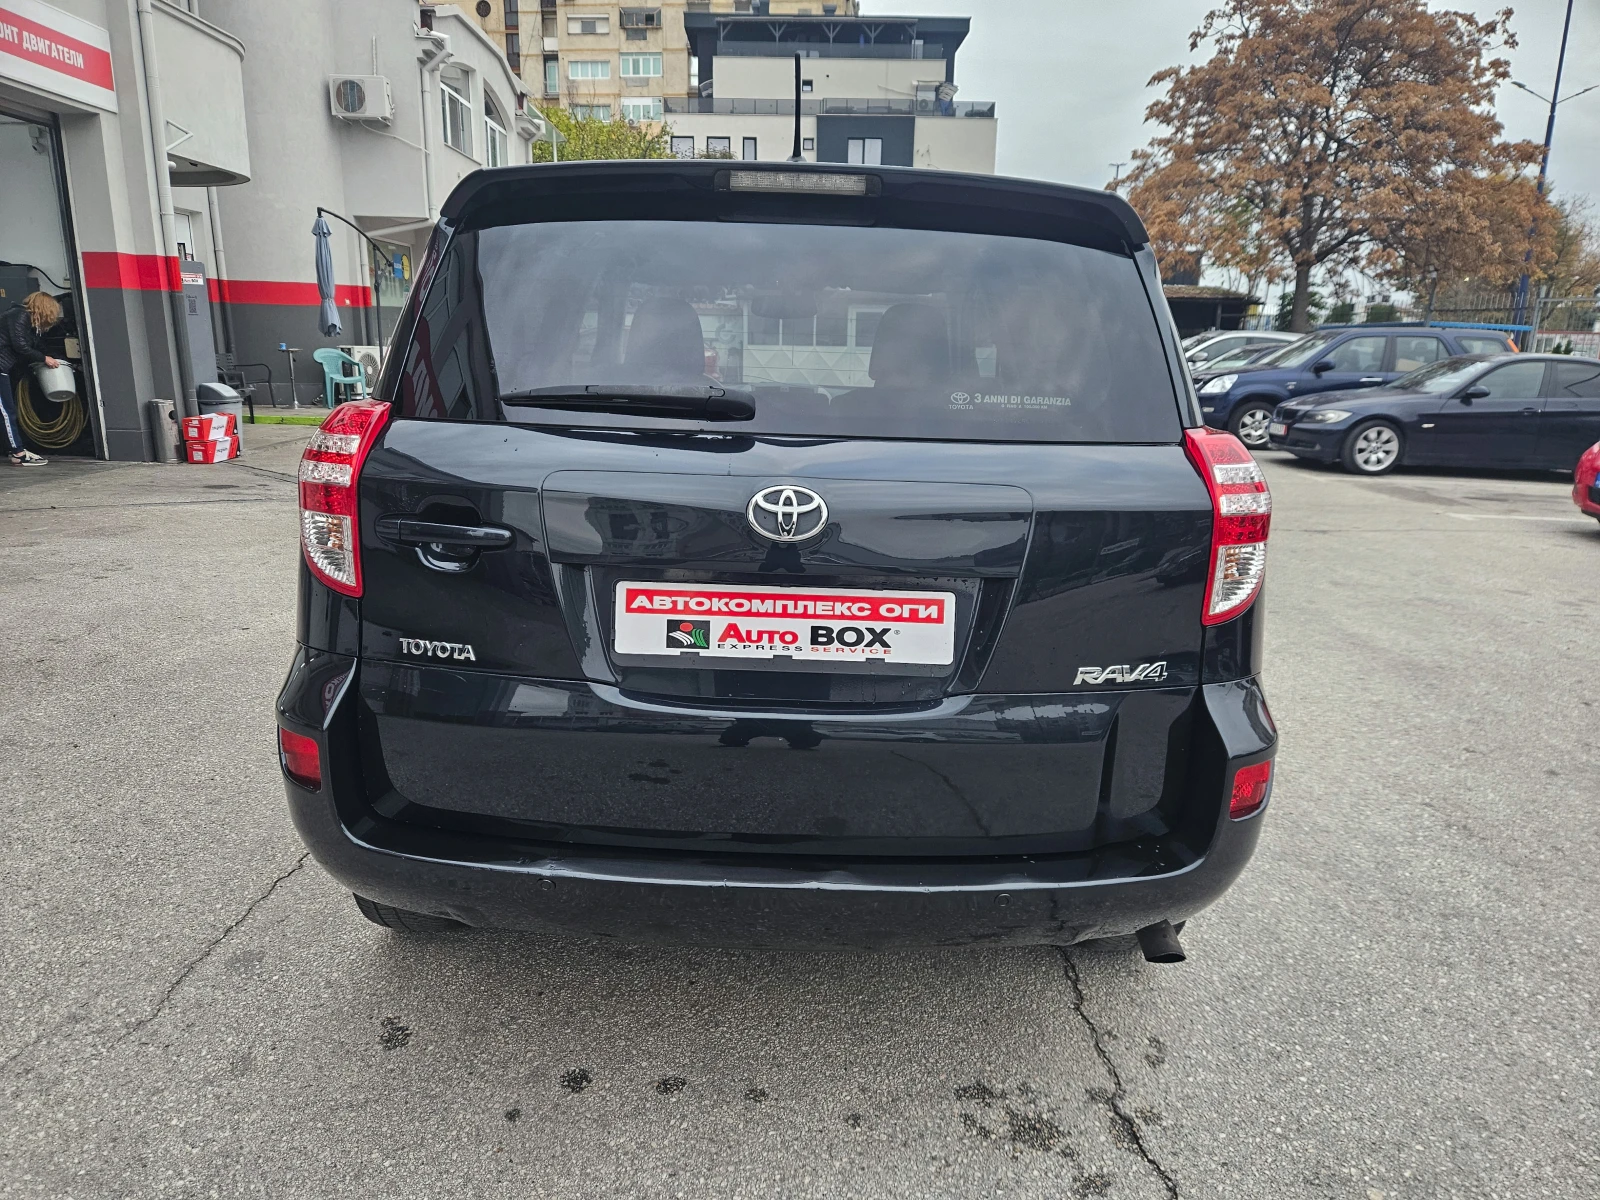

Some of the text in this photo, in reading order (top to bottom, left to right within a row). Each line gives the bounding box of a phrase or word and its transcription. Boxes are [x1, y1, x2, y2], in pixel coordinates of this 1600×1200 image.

[22, 30, 84, 69] ДВИГАТЕЛИ
[974, 393, 1072, 406] 3 ANNI DI GARANZIA
[630, 595, 938, 619] АВТОКОМПЛЕКС ОГИ
[810, 625, 892, 648] BOX
[399, 637, 476, 661] TOYOTA
[717, 643, 892, 655] EXPRESS SERVICE
[1073, 661, 1168, 686] RAV4
